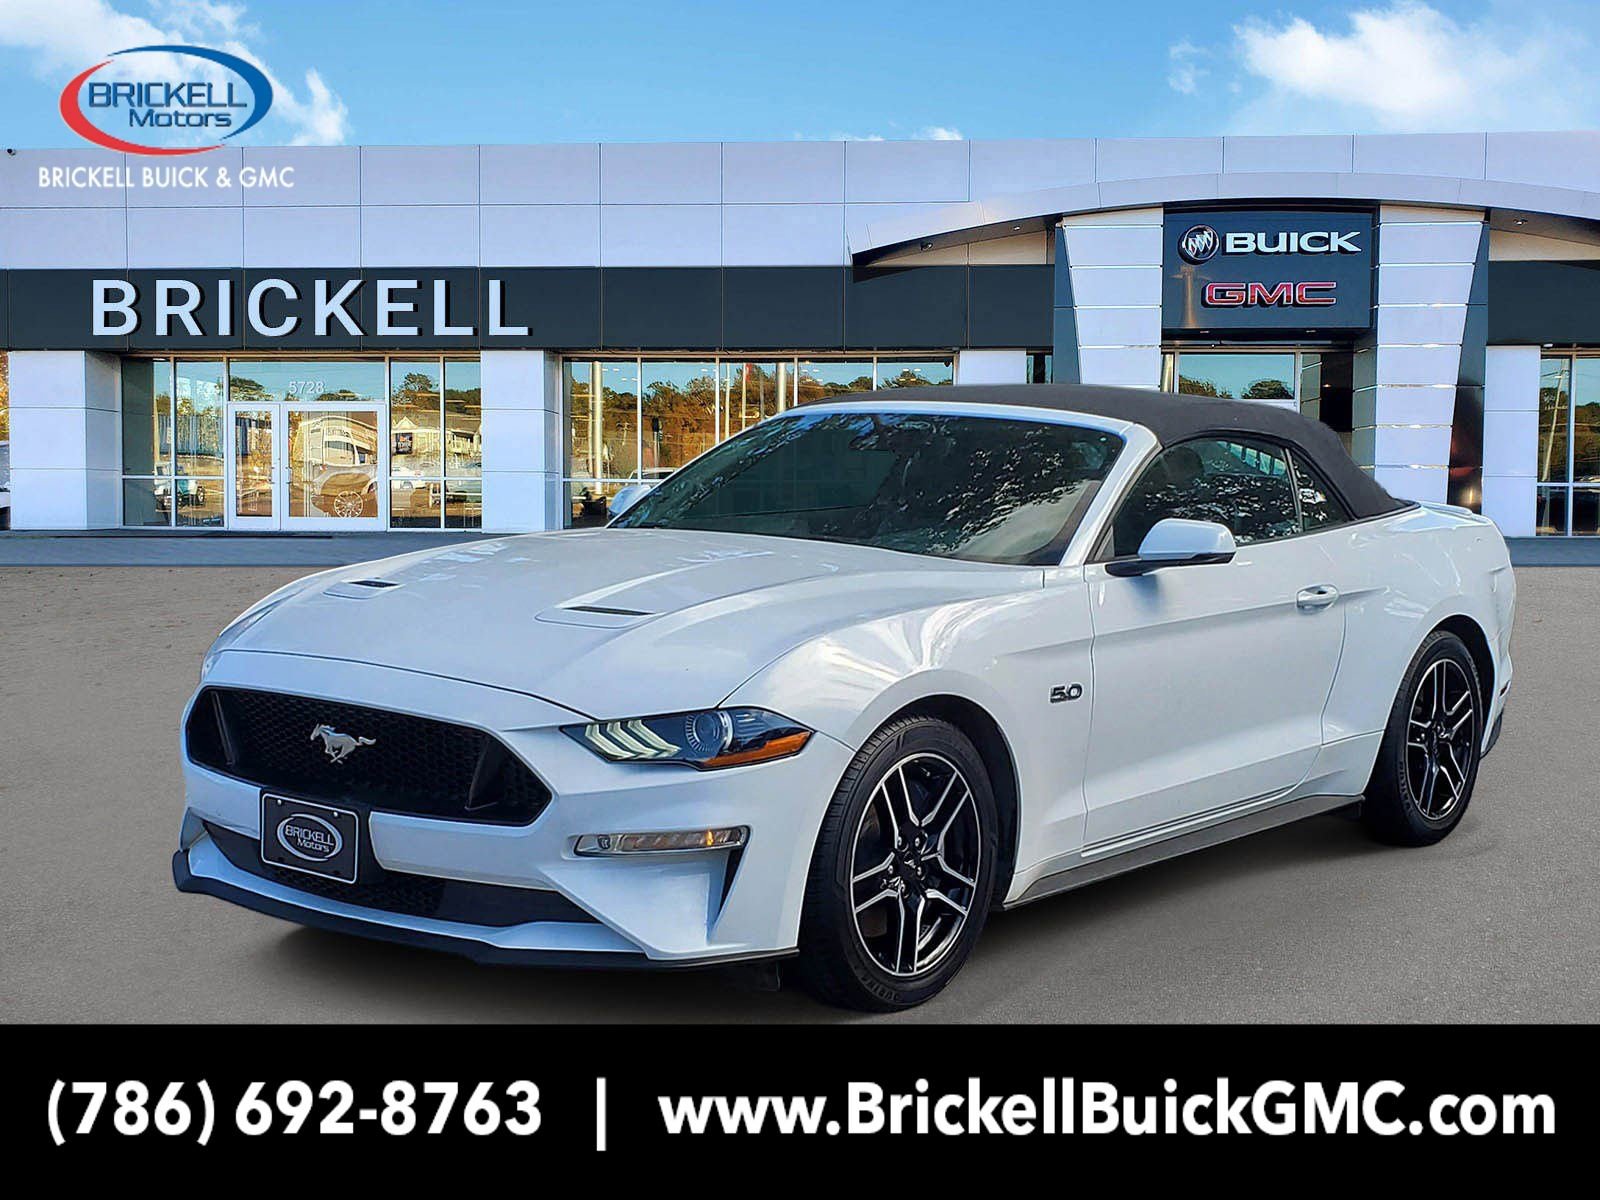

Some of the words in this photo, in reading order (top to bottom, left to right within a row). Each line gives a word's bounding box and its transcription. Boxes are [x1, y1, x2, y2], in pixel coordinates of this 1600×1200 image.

[1225, 232, 1361, 253] BUICK
[1205, 282, 1336, 305] GMC
[92, 279, 530, 337] BRICKELL
[288, 381, 325, 394] 5728
[284, 824, 334, 846] BRICKELL
[297, 838, 330, 853] Motors
